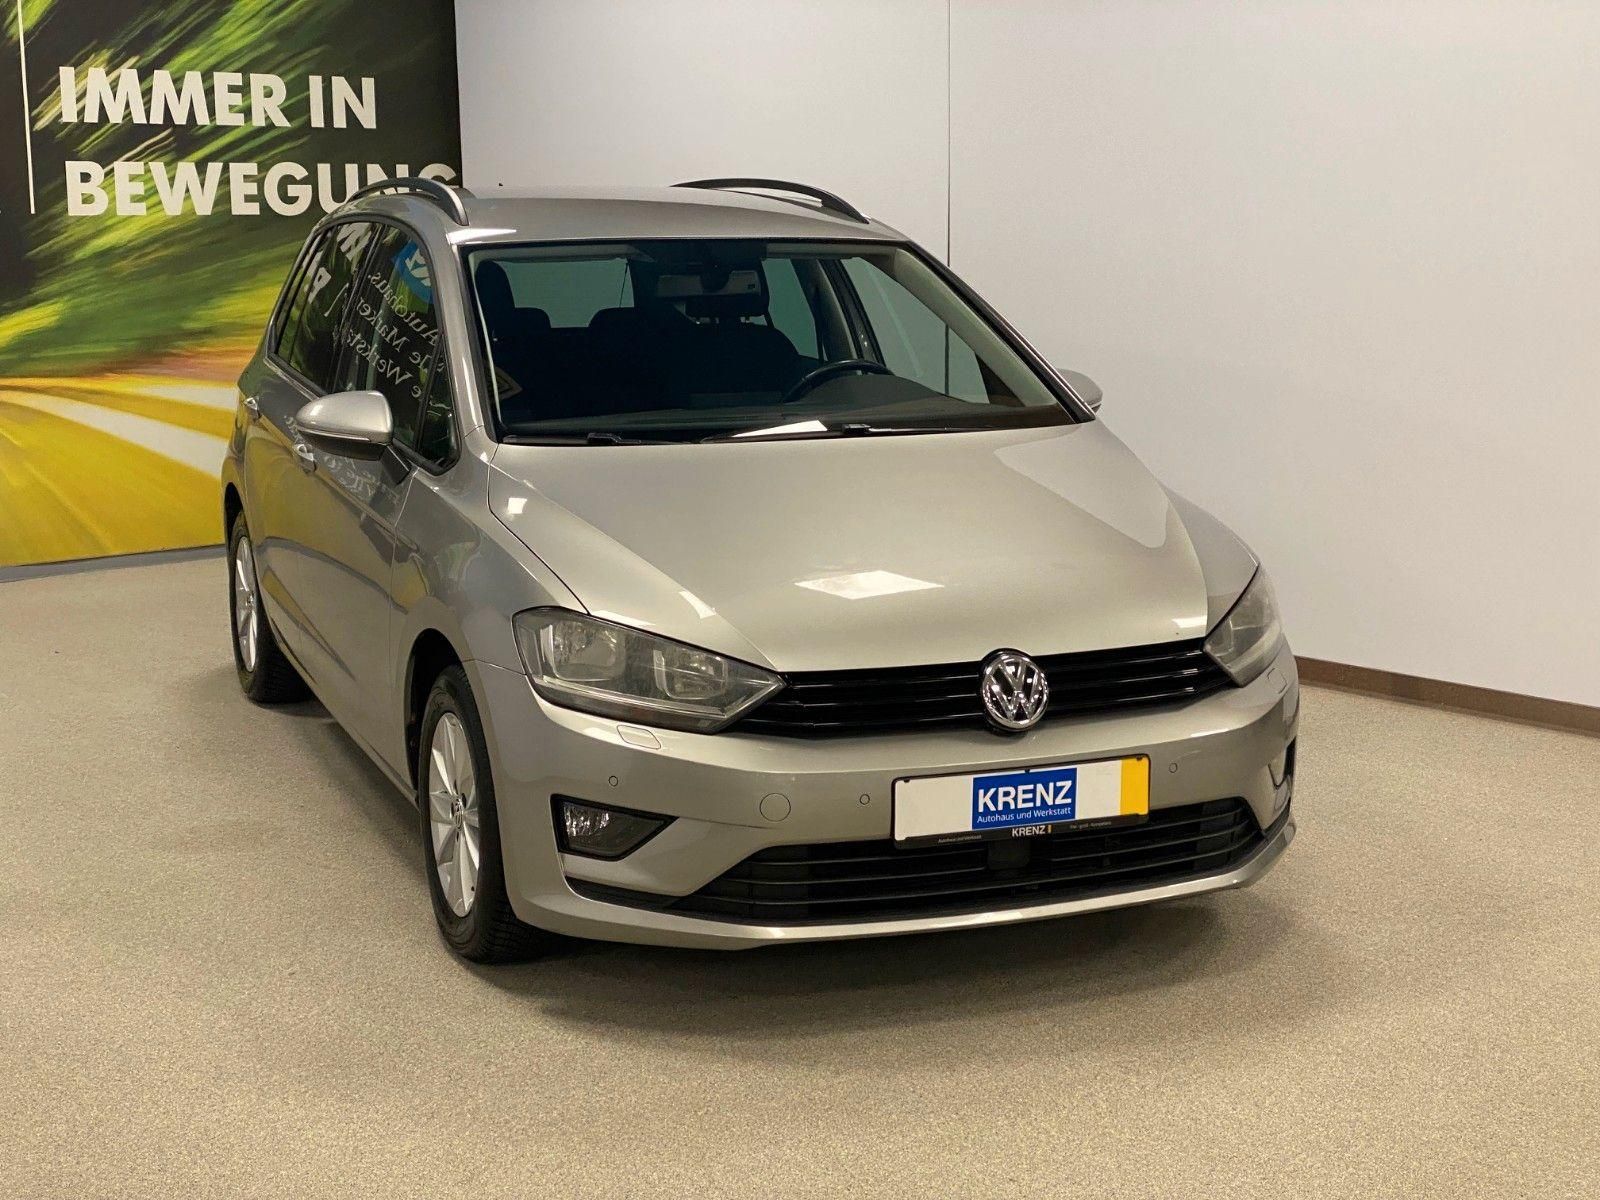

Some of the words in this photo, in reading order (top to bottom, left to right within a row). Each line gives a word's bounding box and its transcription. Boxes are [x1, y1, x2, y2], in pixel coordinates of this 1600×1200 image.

[58, 66, 292, 127] IMMER
[308, 75, 377, 130] IN
[978, 780, 1072, 813] KRENZ
[977, 813, 1015, 823] Autohaus
[1016, 810, 1032, 819] und
[1033, 807, 1072, 818] Werkstatt
[1012, 825, 1046, 837] KRENZ
